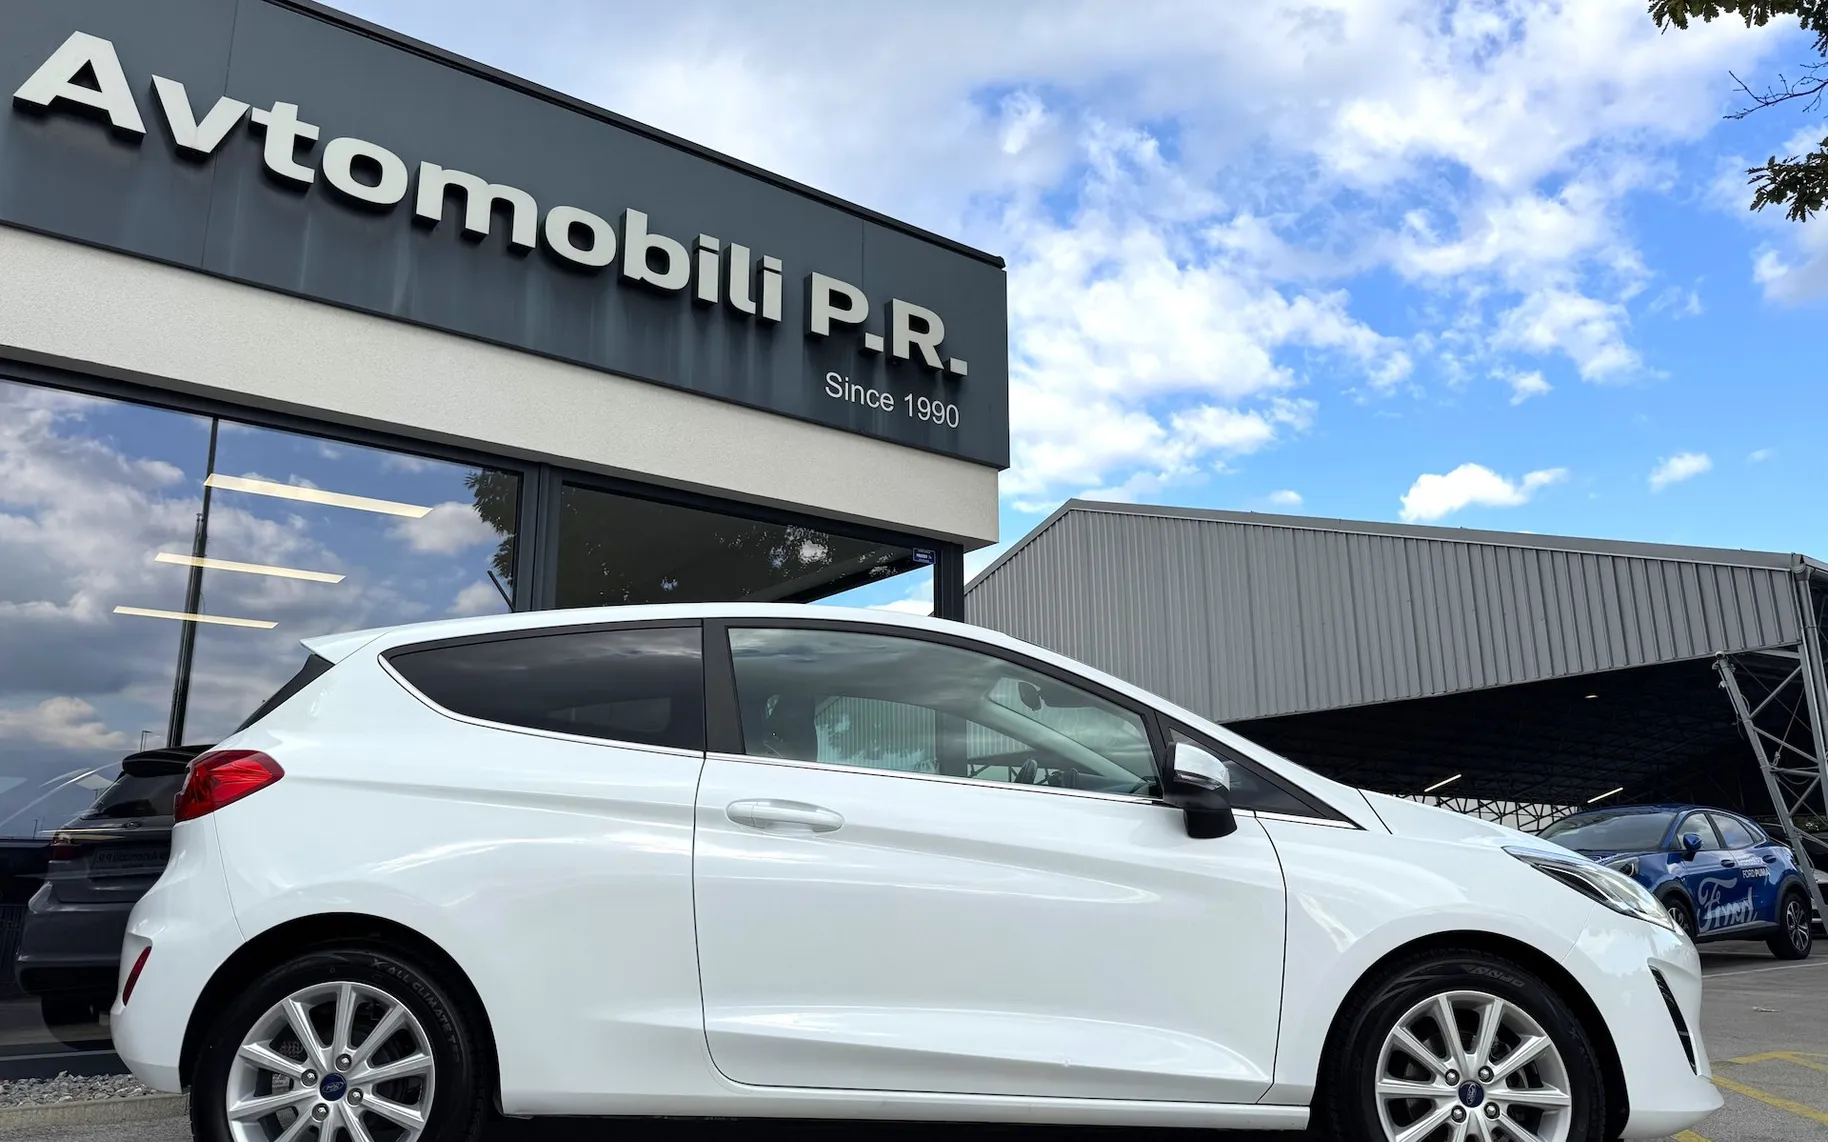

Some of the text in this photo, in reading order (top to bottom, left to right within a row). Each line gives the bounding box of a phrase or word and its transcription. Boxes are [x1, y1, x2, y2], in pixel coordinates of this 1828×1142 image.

[12, 30, 968, 377] Avtomobili P.R.
[824, 371, 960, 428] Since 1990
[1742, 869, 1755, 879] FORD
[387, 966, 410, 984] ALL
[412, 980, 453, 1033] CLIMATE
